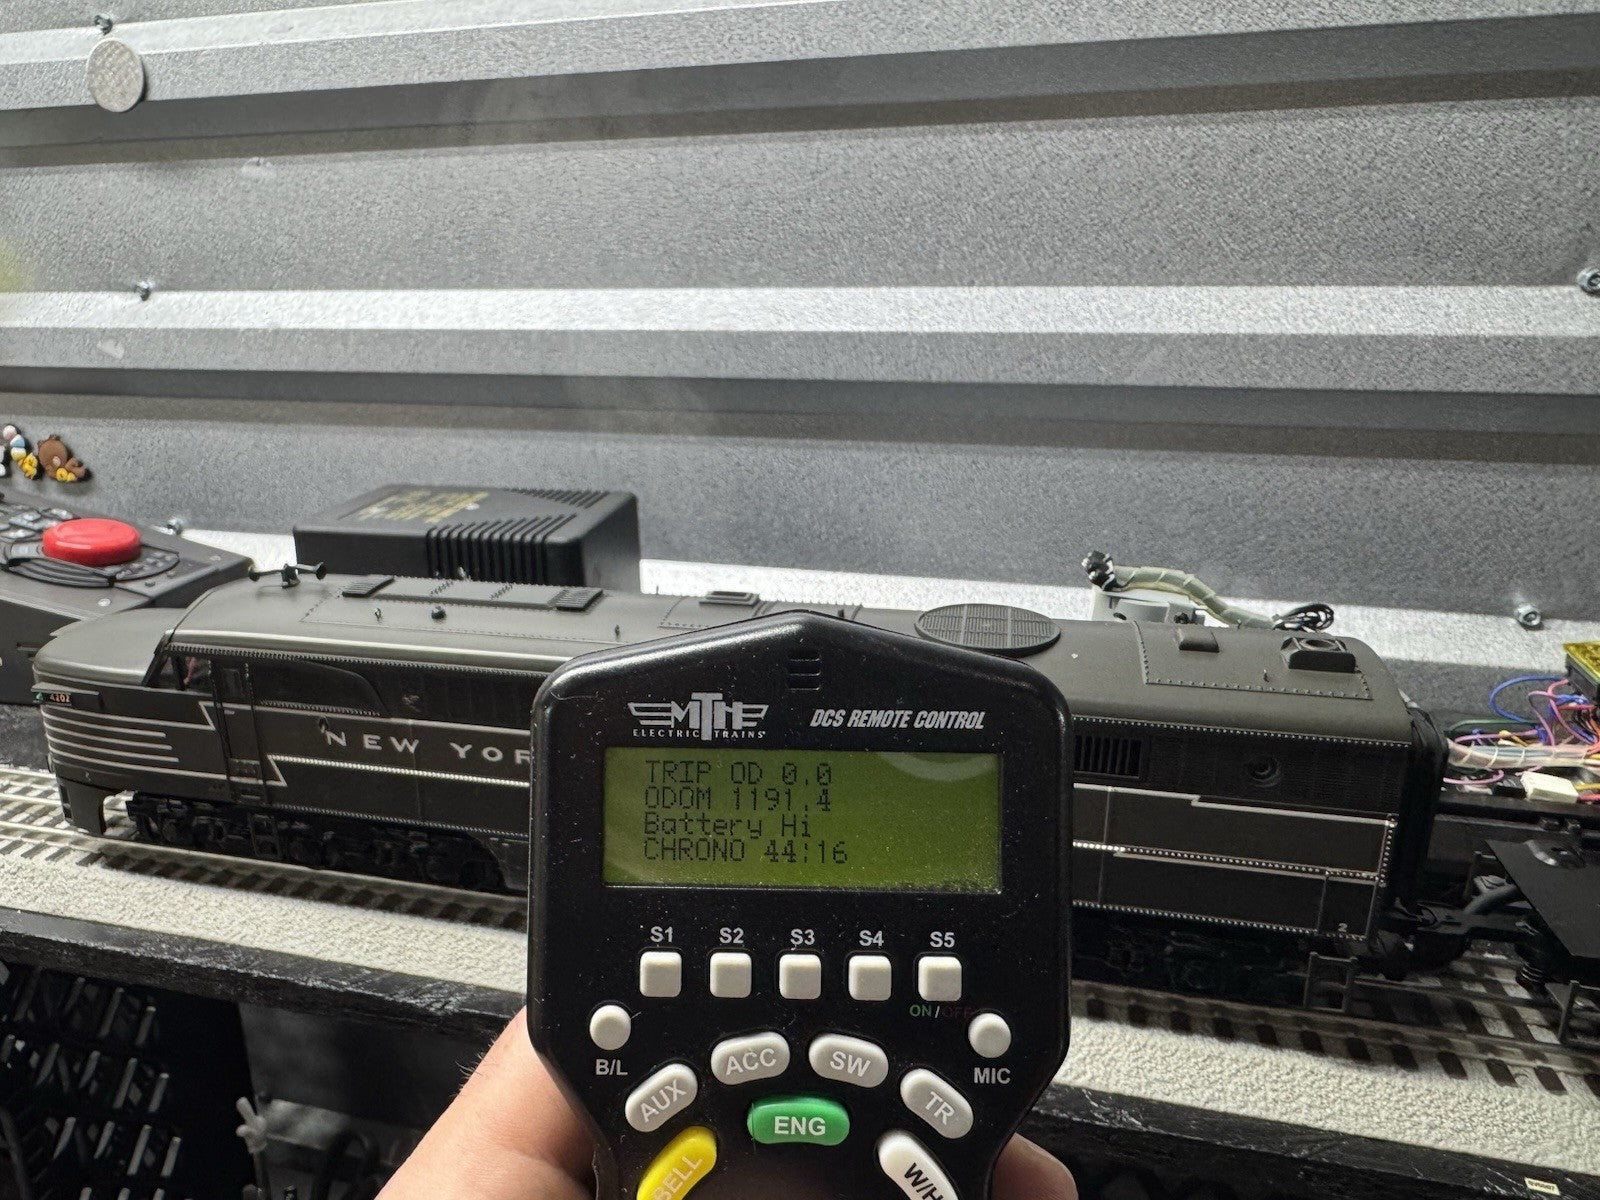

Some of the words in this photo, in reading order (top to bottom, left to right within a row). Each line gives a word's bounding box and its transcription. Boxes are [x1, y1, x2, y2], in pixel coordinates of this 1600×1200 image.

[810, 709, 846, 728] DCS
[847, 709, 913, 728] REMOTE
[914, 710, 985, 729] CONTROL
[633, 728, 699, 738] ELECTRIC
[714, 730, 765, 739] TRAINS
[325, 731, 419, 754] NEW
[450, 742, 531, 765] YOR
[645, 760, 711, 783] TRIP
[731, 761, 762, 784] OD
[782, 762, 831, 785] 0.0
[645, 786, 711, 809] ODOM
[734, 788, 830, 811] 1191.4
[644, 811, 762, 839] Battery
[781, 813, 811, 837] Hi
[644, 837, 744, 861] CHRONO
[764, 839, 847, 863] 44:16
[650, 926, 673, 942] S1
[719, 927, 744, 943] S2
[790, 928, 815, 945] S3
[859, 930, 884, 947] S4
[930, 931, 955, 948] S5
[595, 1059, 628, 1075] B/L
[726, 1048, 777, 1075] ACC
[830, 1051, 870, 1077] SW
[973, 1067, 1011, 1084] MIC
[640, 1079, 687, 1123] AUX
[925, 1091, 955, 1125] TR
[774, 1116, 826, 1135] ENG
[653, 1156, 702, 1200] BELL
